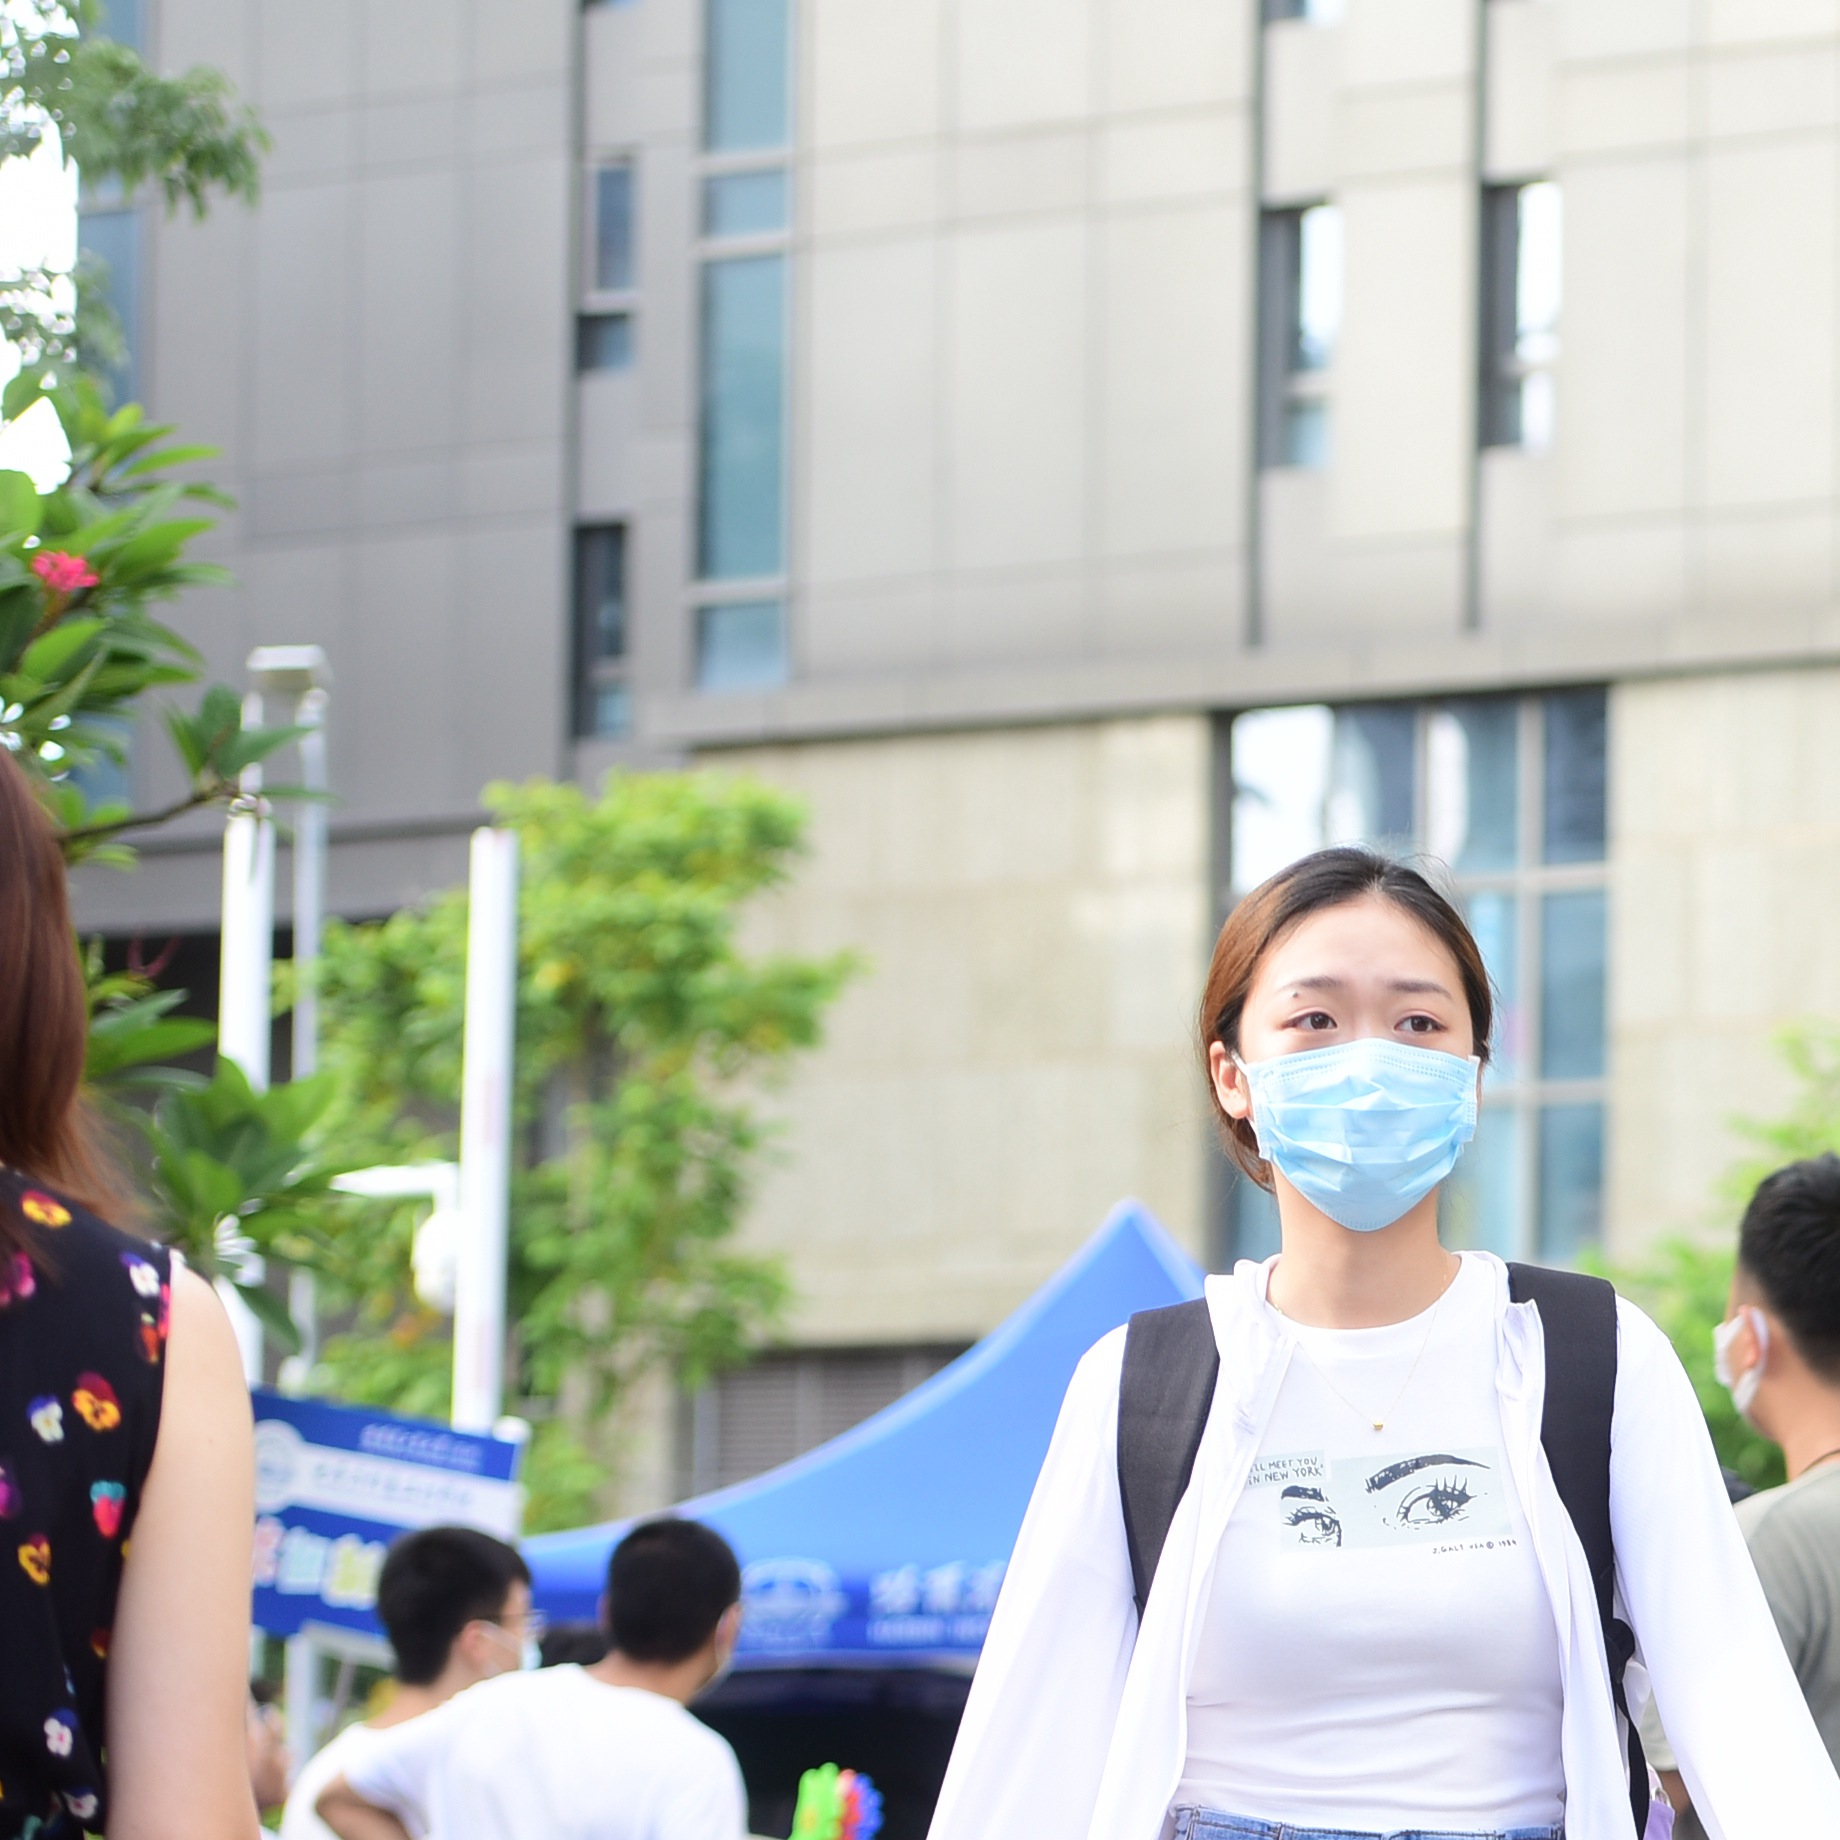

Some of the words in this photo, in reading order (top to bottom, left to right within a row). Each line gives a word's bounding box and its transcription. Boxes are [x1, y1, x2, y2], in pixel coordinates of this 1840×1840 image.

[1268, 1459, 1293, 1470] MEET
[1297, 1457, 1318, 1467] YOU
[1265, 1471, 1289, 1482] NEW
